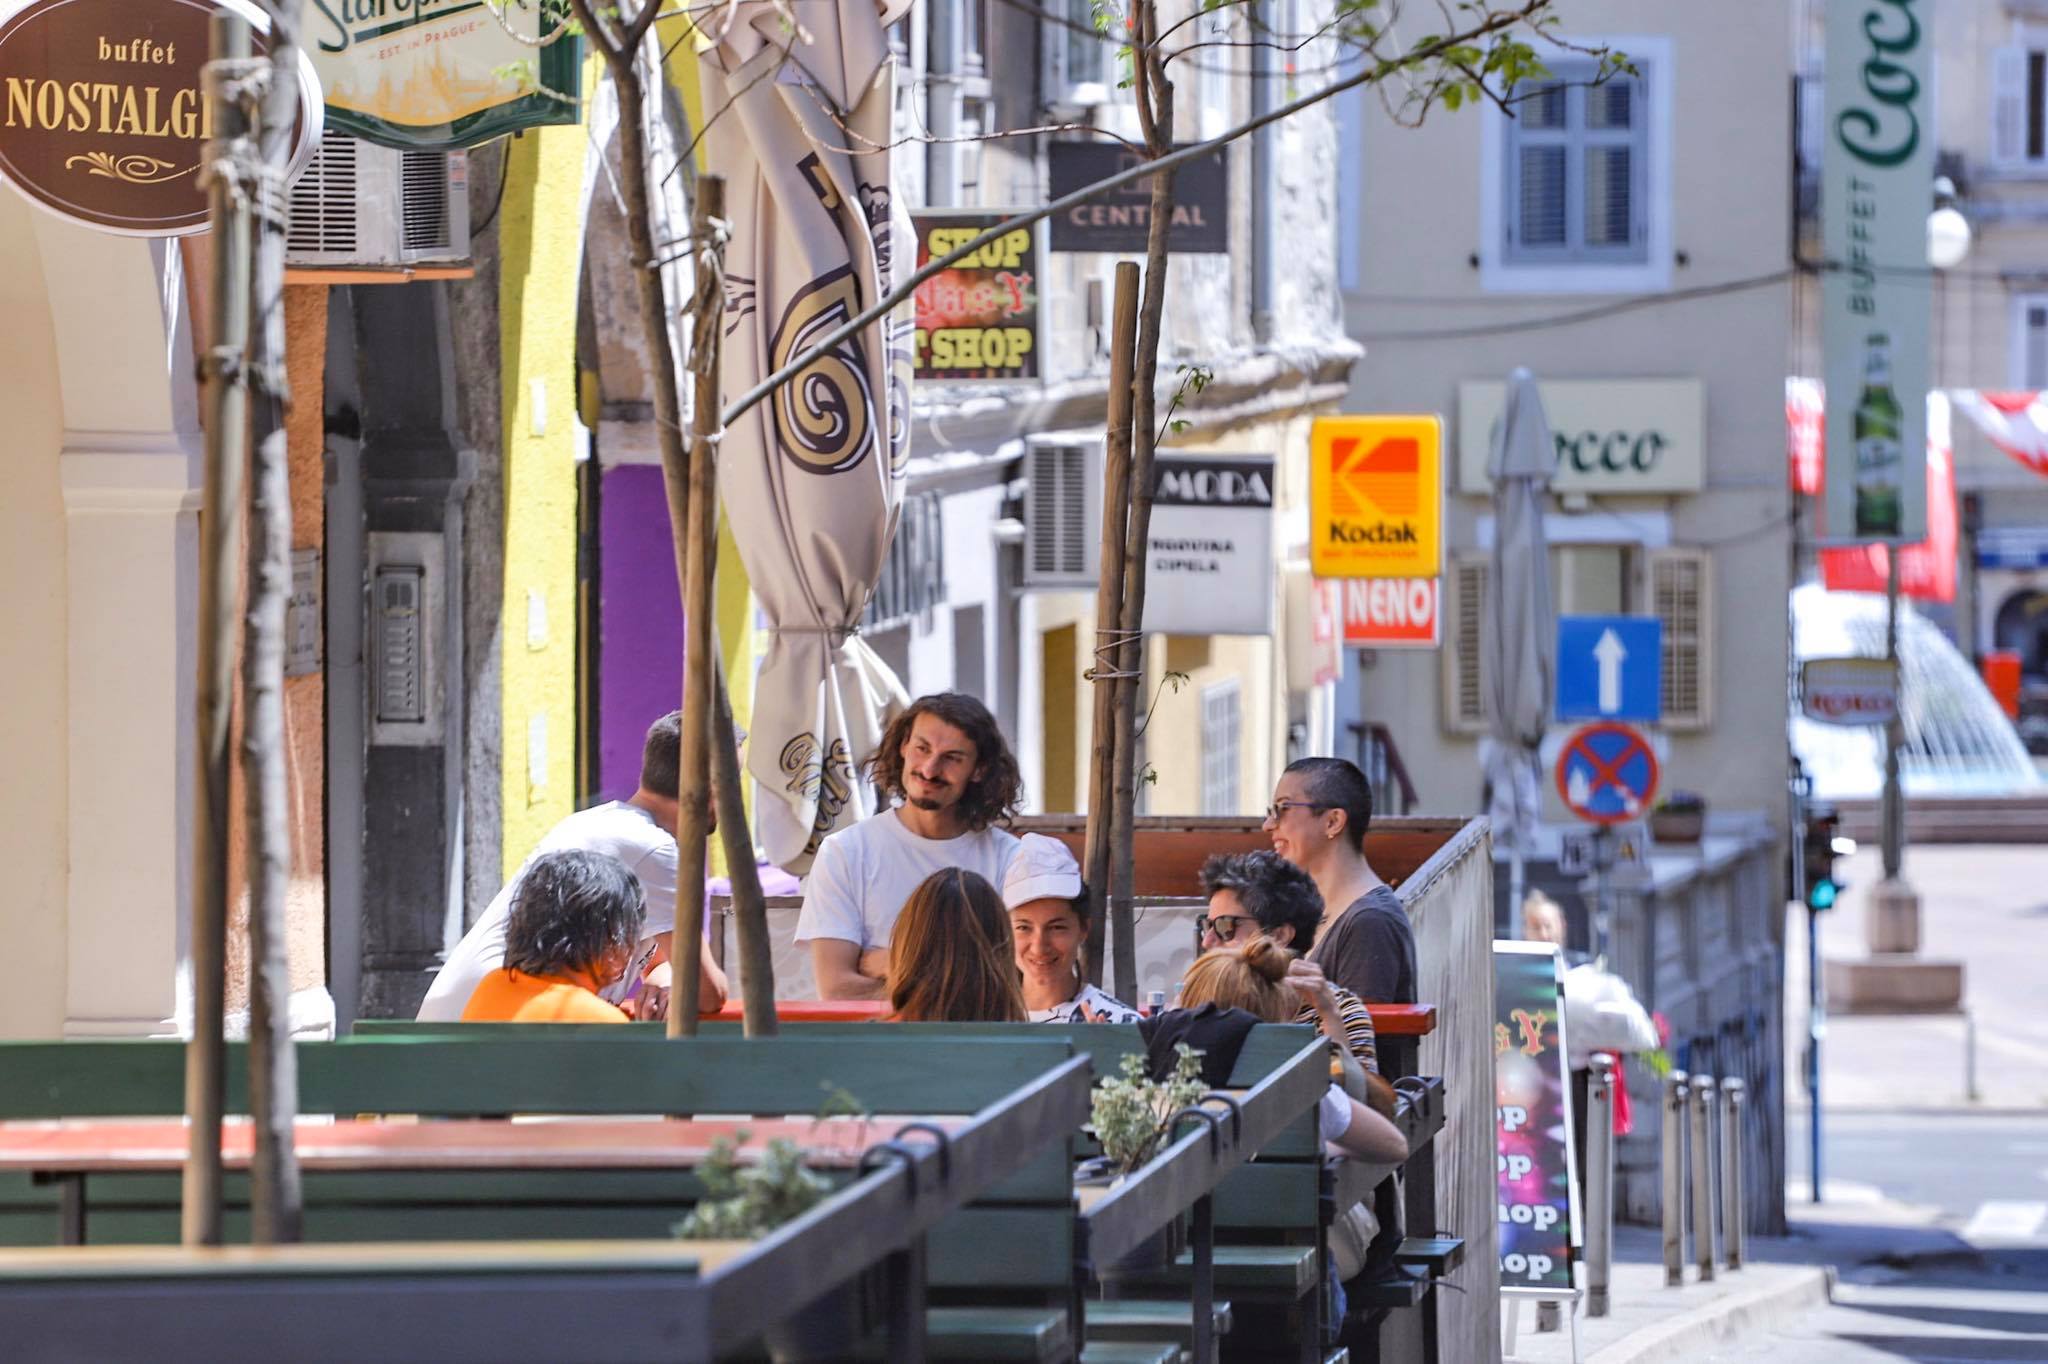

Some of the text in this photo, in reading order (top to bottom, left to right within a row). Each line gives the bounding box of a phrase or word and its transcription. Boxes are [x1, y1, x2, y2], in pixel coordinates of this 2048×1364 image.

[99, 36, 176, 65] buffet
[378, 46, 400, 59] EST
[425, 21, 476, 42] PRAGUE
[1069, 205, 1207, 227] CENTAL
[928, 228, 1030, 268] SHOP
[1848, 175, 1875, 317] BUFFET
[931, 328, 1032, 369] SHOP
[1156, 469, 1271, 502] MODA
[1330, 521, 1418, 543] Kodak
